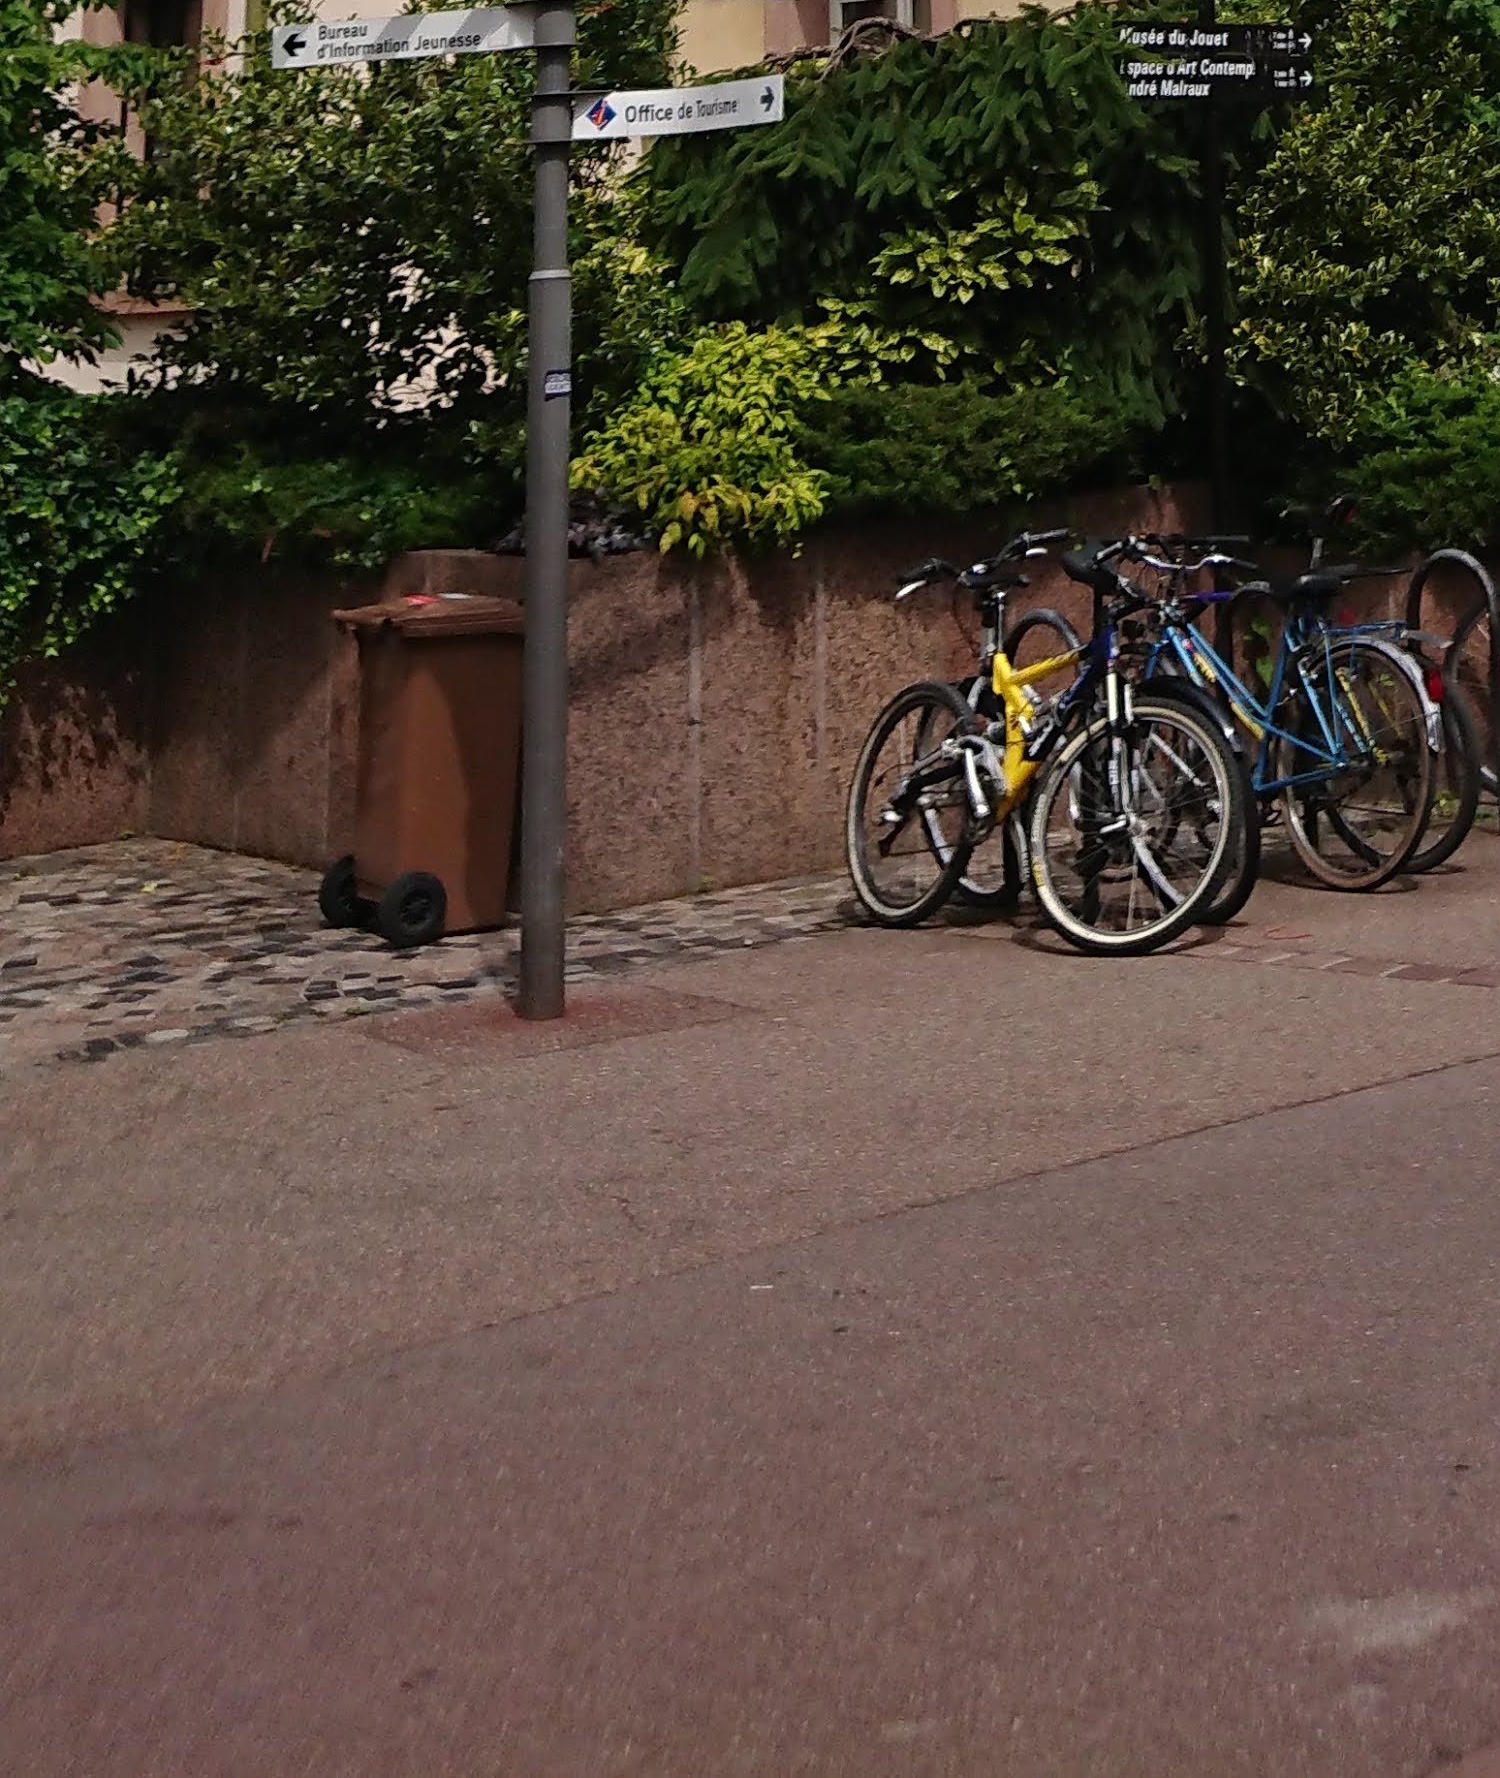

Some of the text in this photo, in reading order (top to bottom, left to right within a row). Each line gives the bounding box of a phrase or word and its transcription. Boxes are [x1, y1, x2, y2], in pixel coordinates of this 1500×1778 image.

[318, 24, 368, 41] Bureau
[1169, 29, 1186, 45] du
[1190, 29, 1229, 46] Jouet
[317, 33, 481, 59] d'Information Jeunesse
[1125, 80, 1211, 96] ndré Malraux
[625, 99, 738, 122] Office de Tourisme
